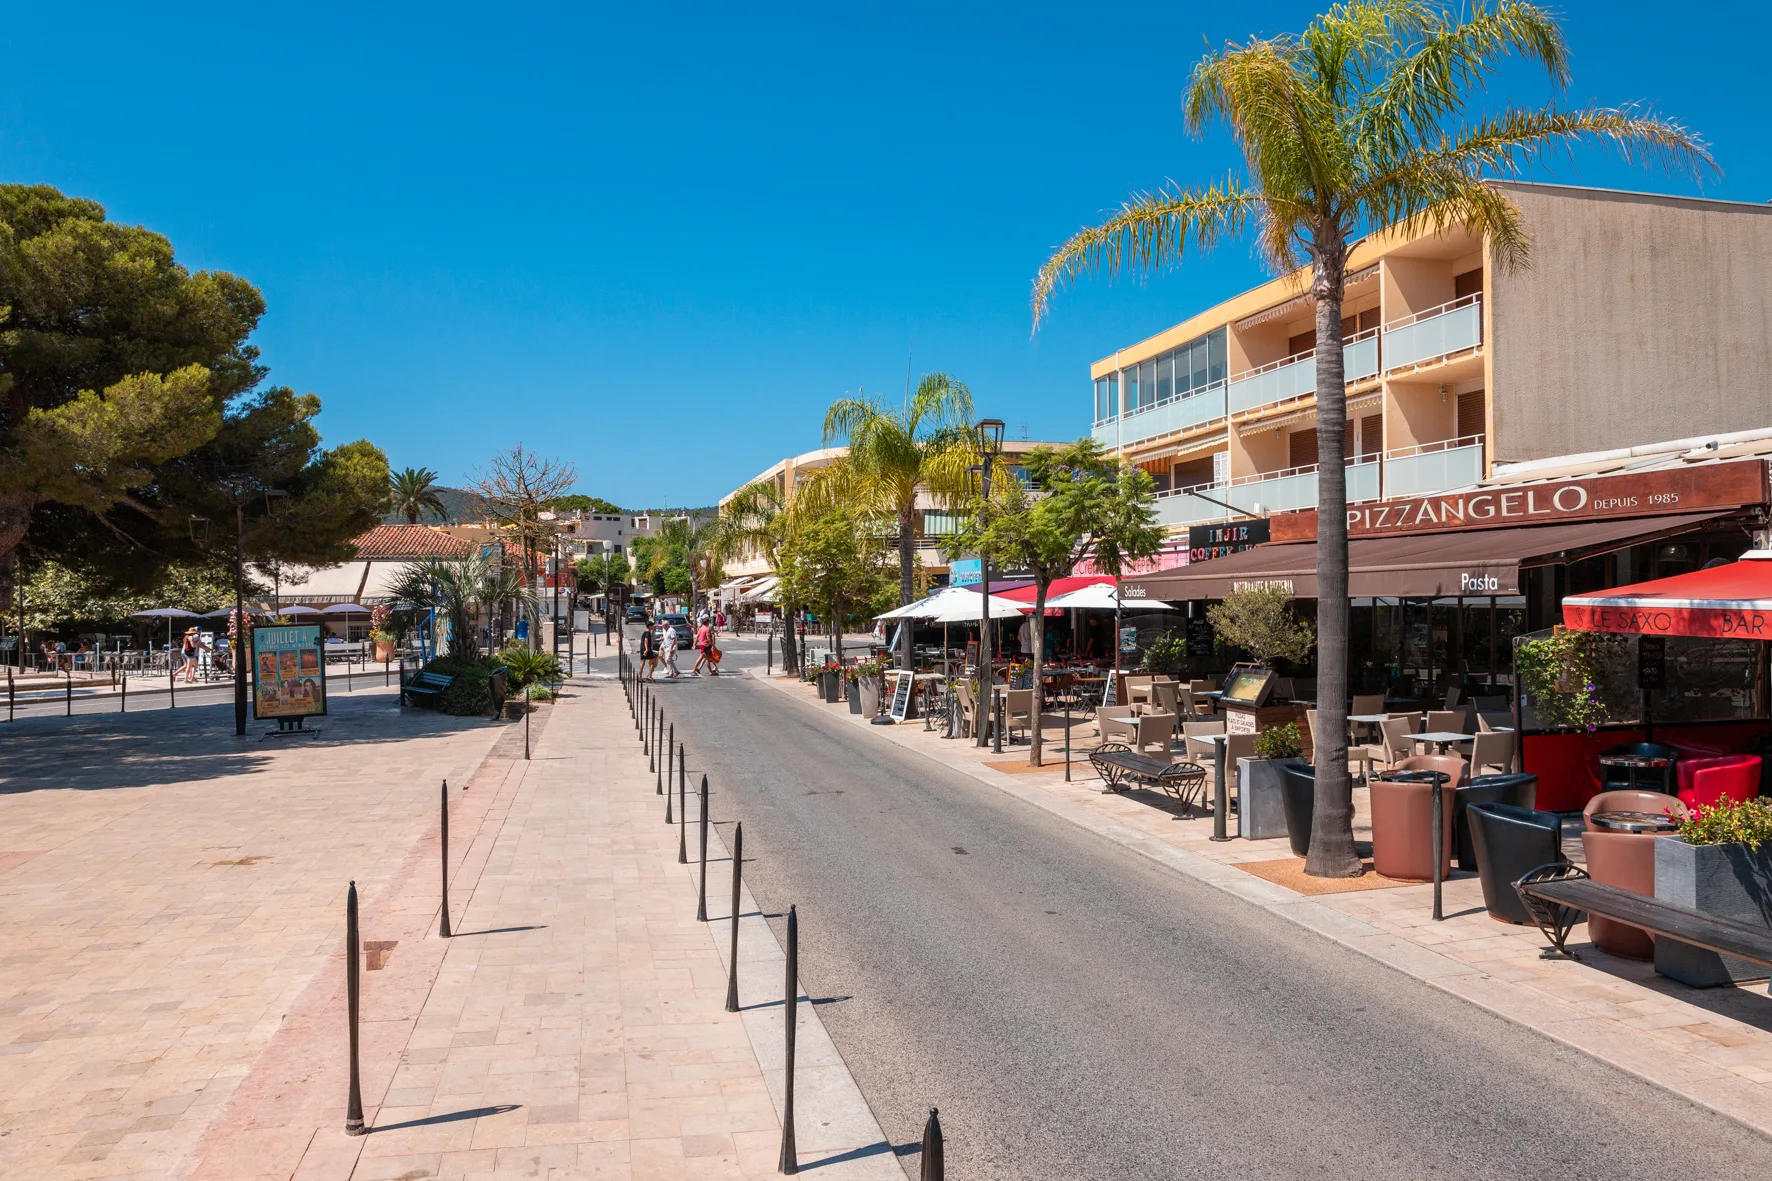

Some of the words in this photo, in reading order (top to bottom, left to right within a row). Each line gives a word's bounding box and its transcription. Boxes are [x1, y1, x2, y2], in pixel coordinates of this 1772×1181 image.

[1346, 485, 1587, 530] PIZZANGELO
[1594, 496, 1638, 510] DEPUIS
[1648, 492, 1679, 505] 1985
[1209, 527, 1249, 543] INJIR
[1191, 546, 1234, 561] COFFEE
[1461, 573, 1498, 591] Pasta
[1124, 585, 1147, 598] Salades
[1591, 607, 1610, 628] LE
[1618, 610, 1672, 631] SAXO
[1722, 613, 1765, 635] BAR
[266, 631, 299, 645] JUILLET
